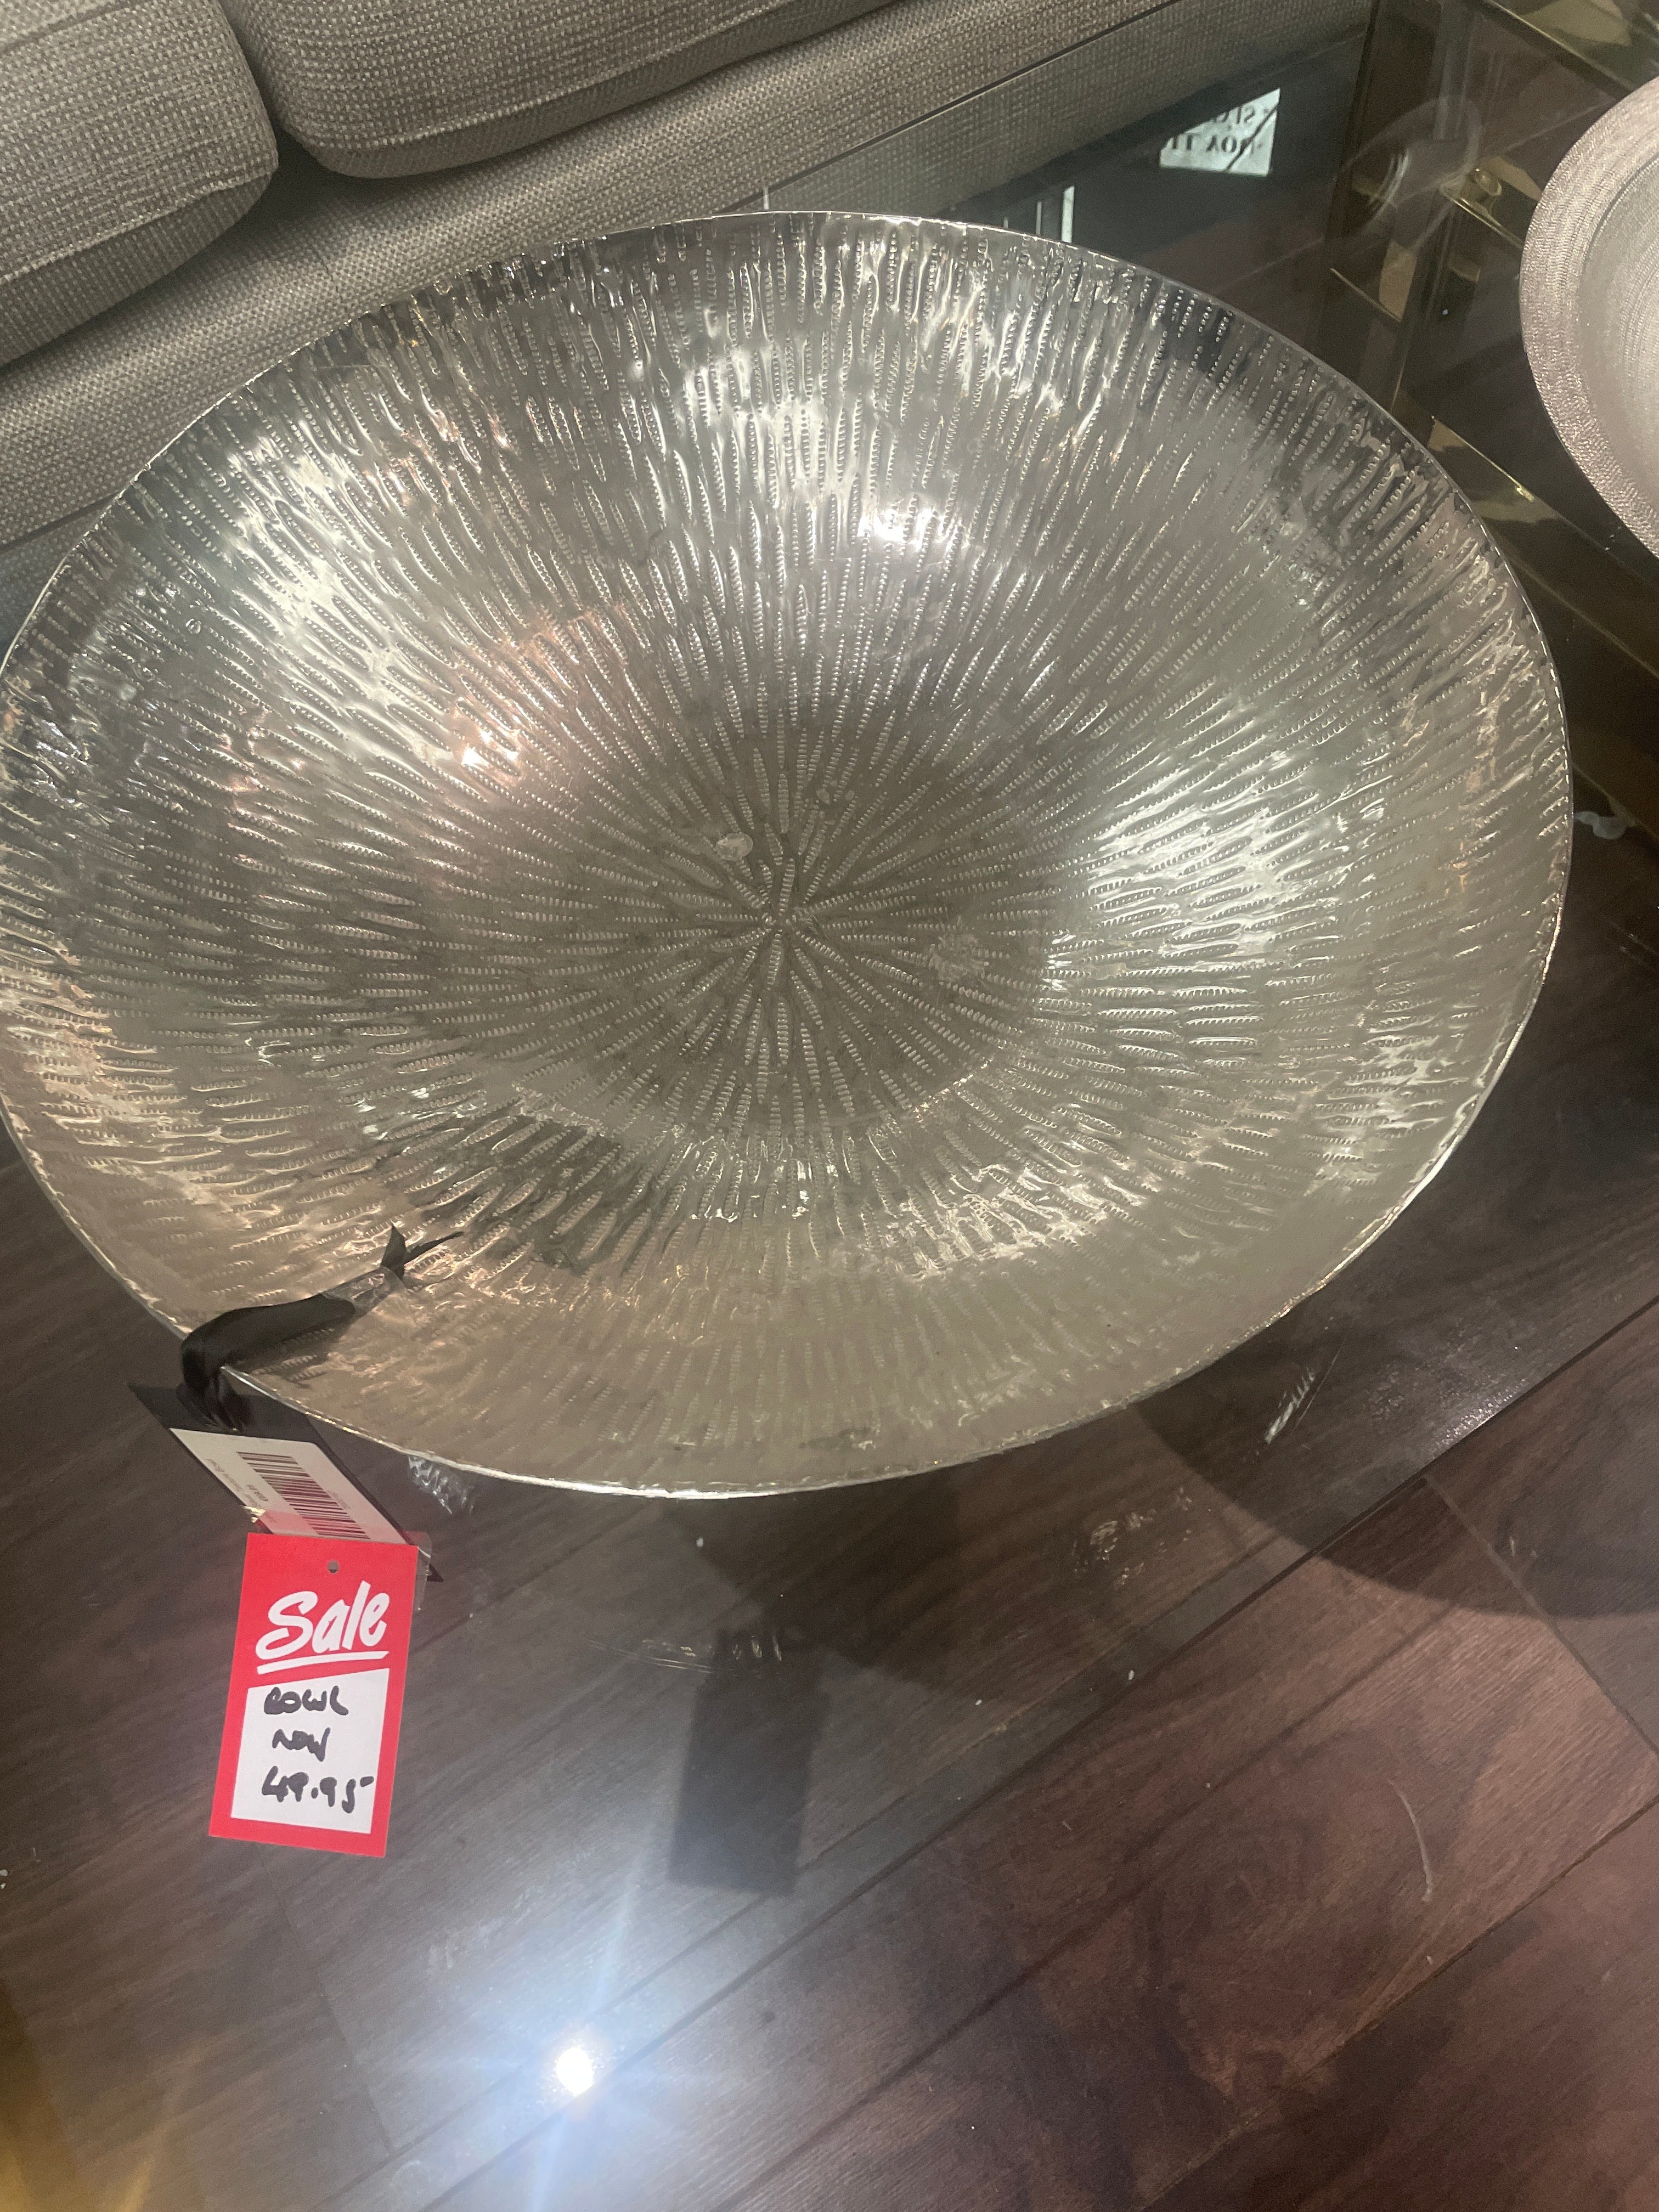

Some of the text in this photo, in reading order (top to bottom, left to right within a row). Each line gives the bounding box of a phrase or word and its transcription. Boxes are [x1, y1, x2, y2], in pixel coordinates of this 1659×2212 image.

[255, 1580, 390, 1661] Sale
[264, 1685, 349, 1716] BOWL
[272, 1727, 330, 1762] NOW
[261, 1765, 375, 1814] 49.95
